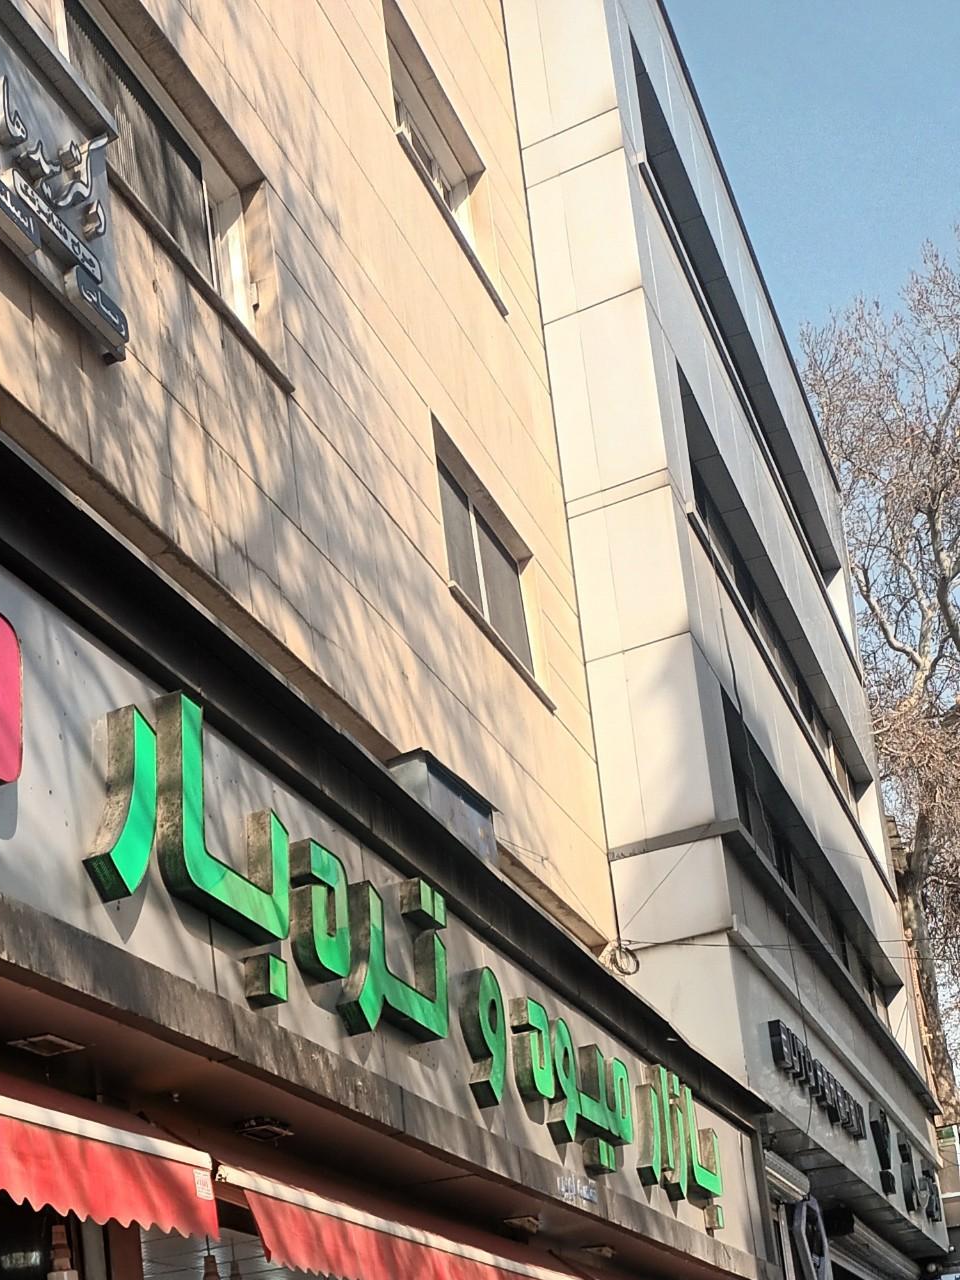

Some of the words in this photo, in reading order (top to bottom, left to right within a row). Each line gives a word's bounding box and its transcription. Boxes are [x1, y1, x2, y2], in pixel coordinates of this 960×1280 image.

[26, 139, 62, 200] سید
[54, 134, 108, 240] دکتر
[86, 691, 289, 1006] بار
[292, 838, 449, 1041] تره
[463, 966, 507, 1107] و
[510, 997, 634, 1174] میوه
[637, 1063, 724, 1229] بازار
